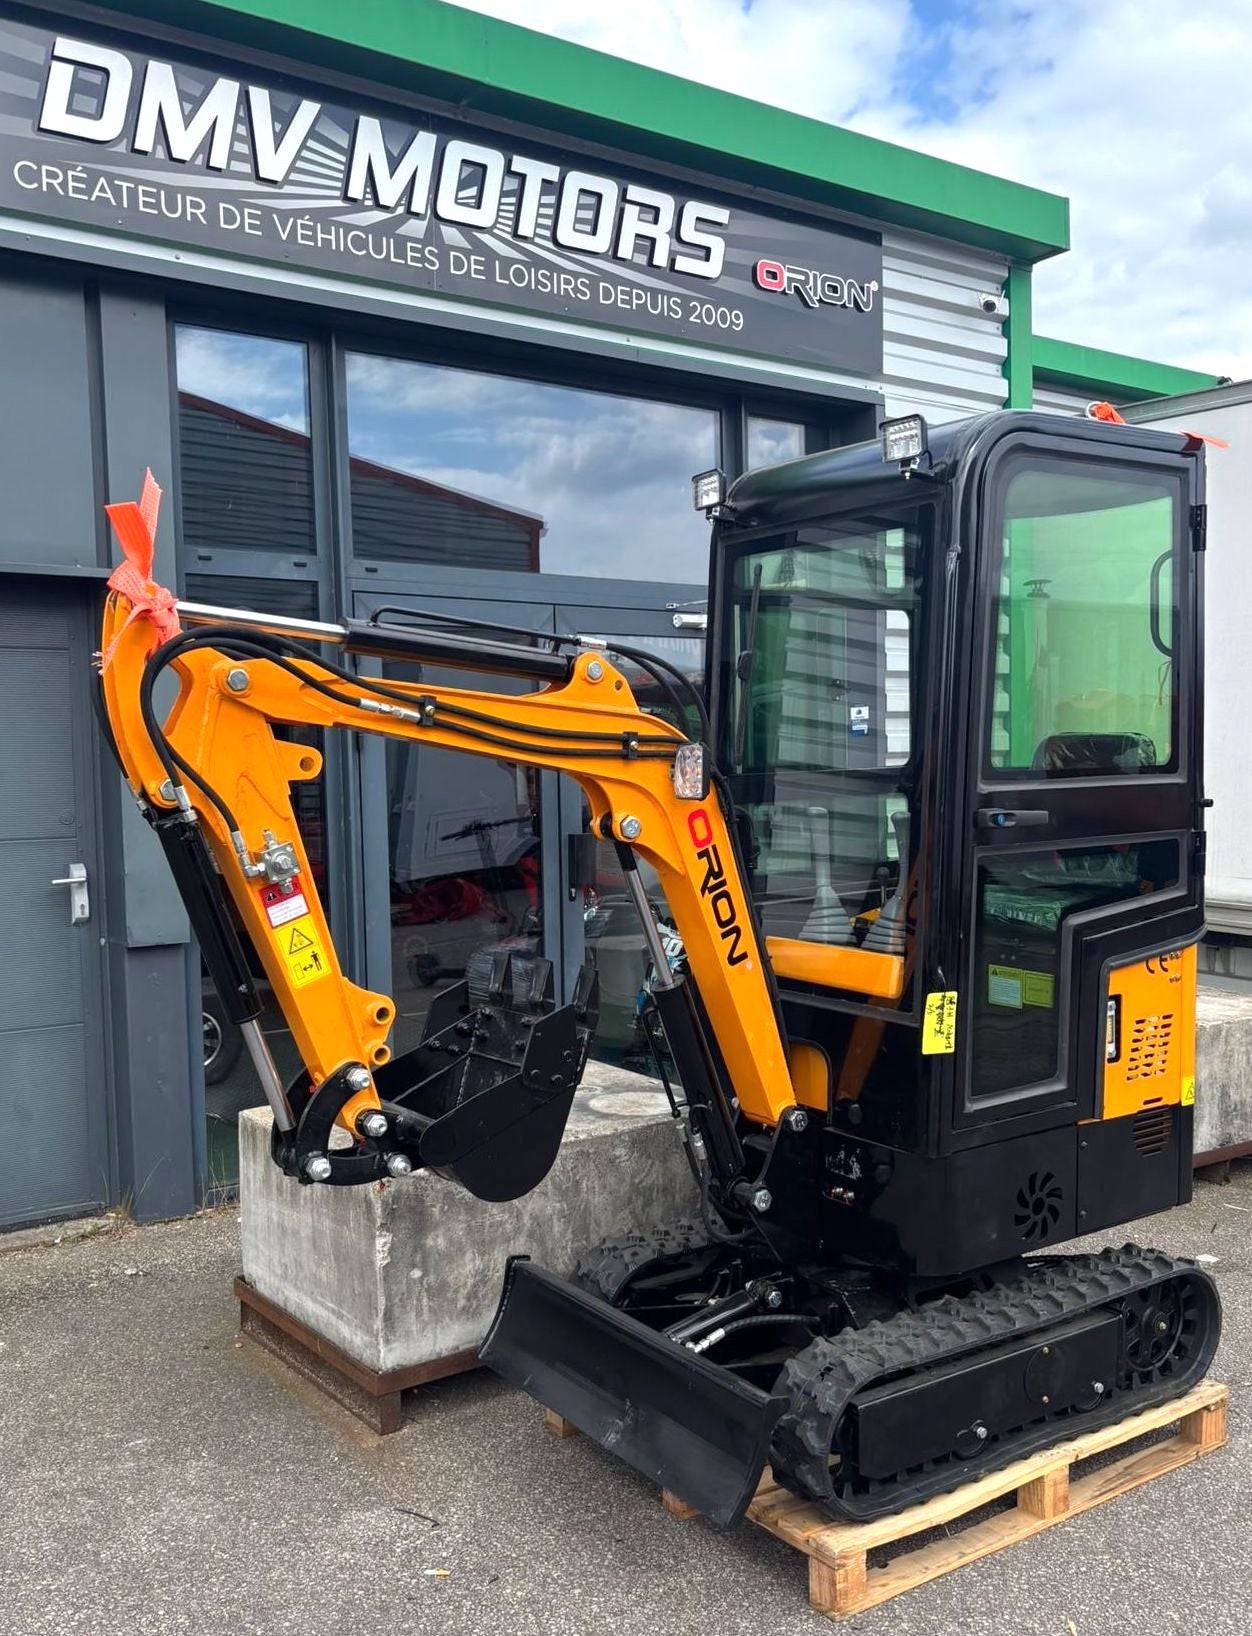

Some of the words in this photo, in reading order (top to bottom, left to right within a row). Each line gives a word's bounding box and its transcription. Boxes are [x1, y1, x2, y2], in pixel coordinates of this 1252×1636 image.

[38, 36, 321, 184] DMV
[344, 115, 731, 280] MOTORS
[12, 161, 208, 224] CRÉATEUR
[219, 203, 262, 236] DE
[272, 213, 440, 271] VÉHICULES
[450, 251, 487, 281] DE
[496, 264, 591, 301] LOISIRS
[599, 282, 682, 319] DEPUIS
[689, 301, 744, 331] 2009
[755, 259, 874, 312] ORION
[688, 808, 749, 967] ORION
